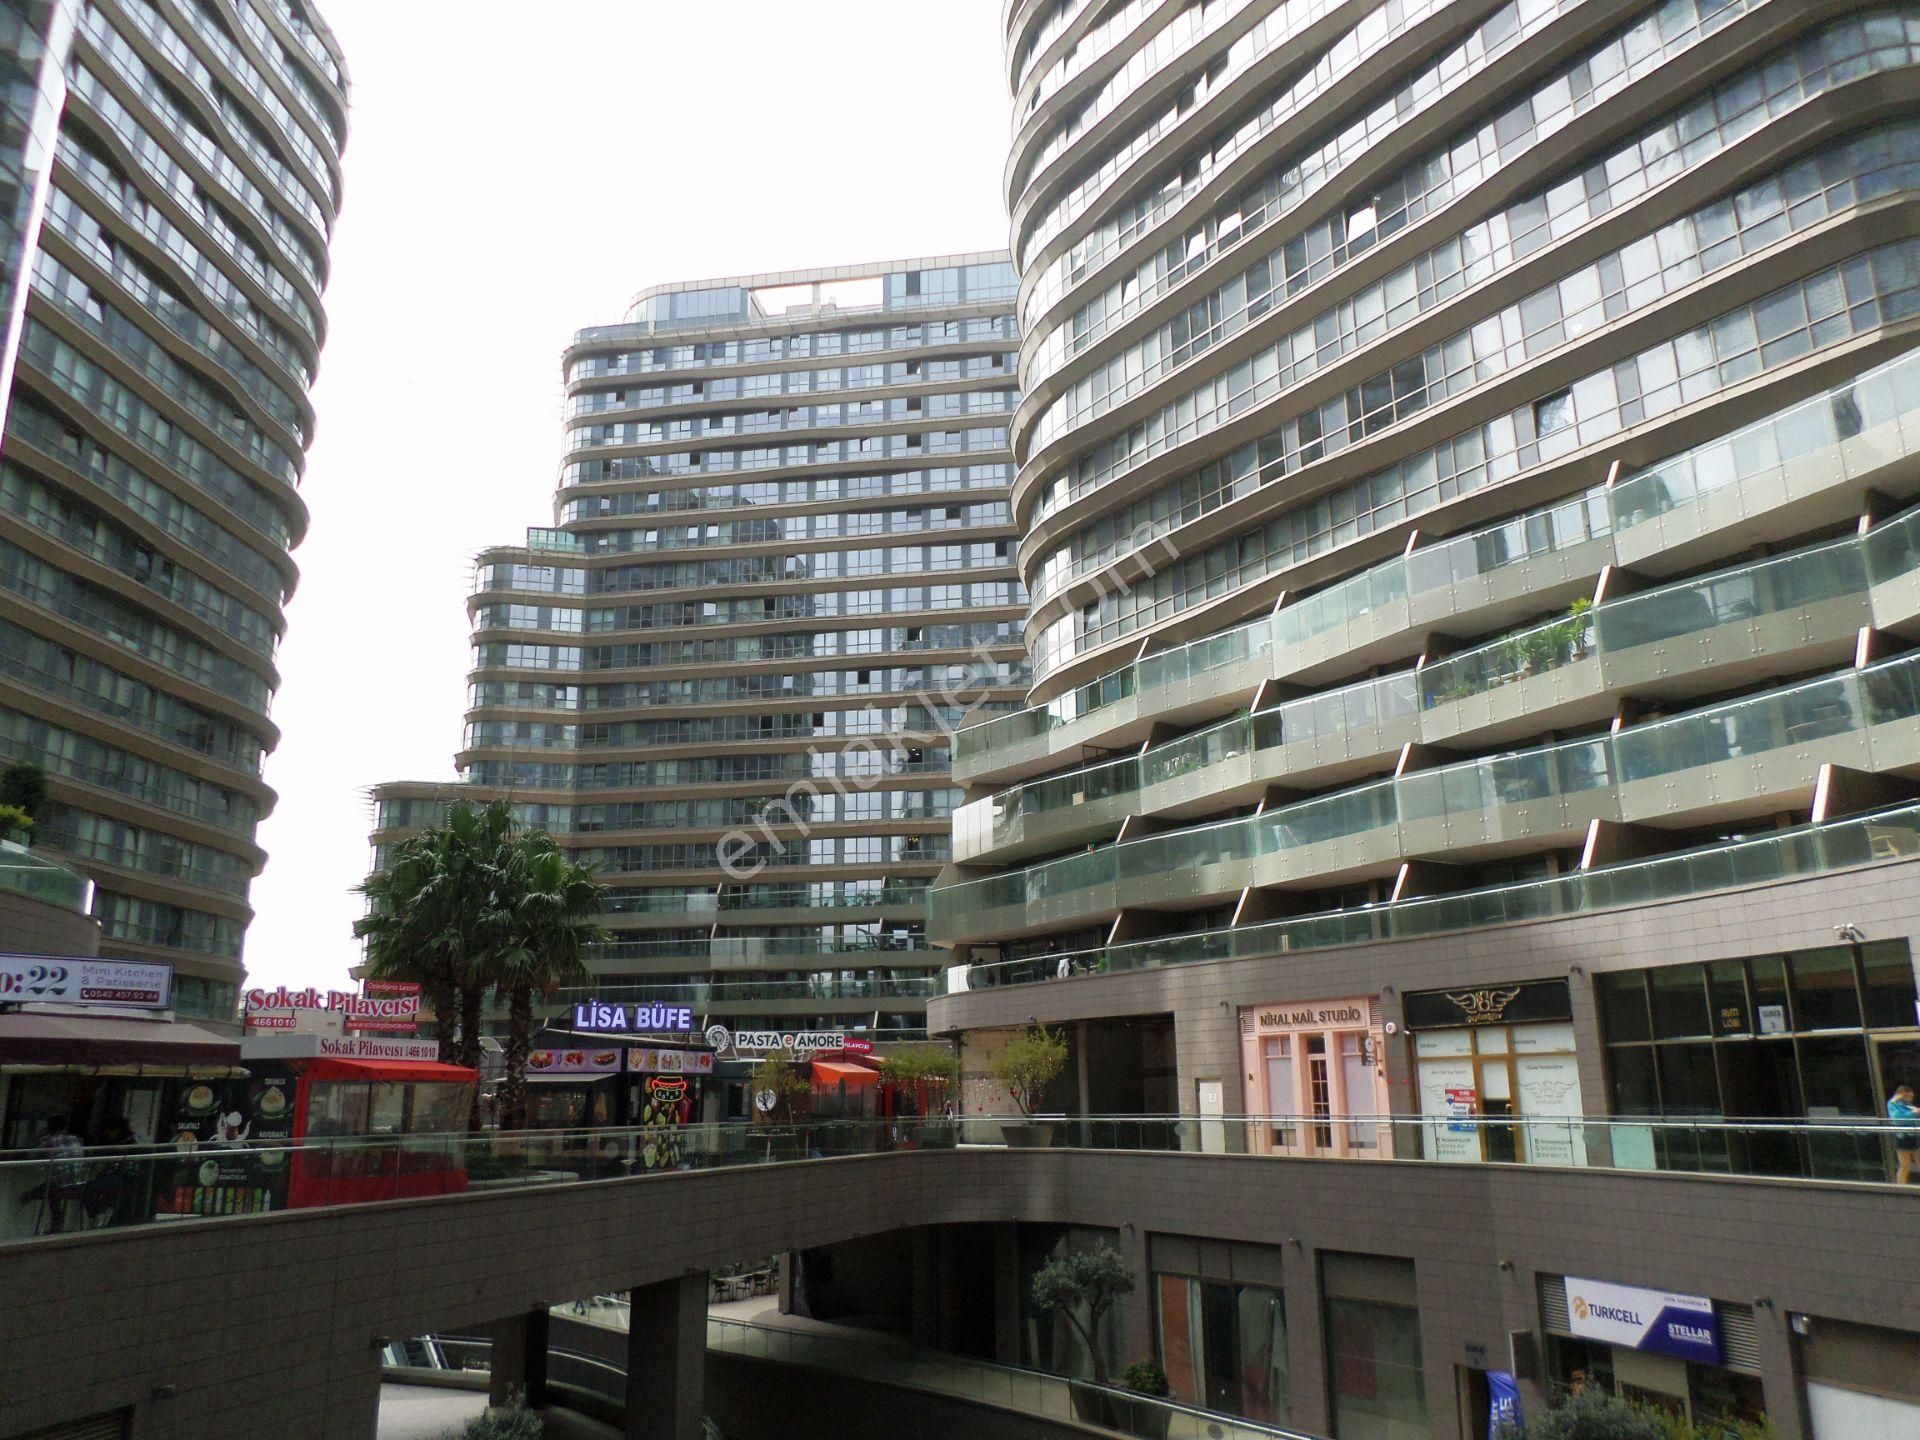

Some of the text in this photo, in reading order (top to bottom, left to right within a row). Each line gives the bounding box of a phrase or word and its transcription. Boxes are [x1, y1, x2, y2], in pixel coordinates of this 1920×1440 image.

[82, 965, 164, 978] Mini Kitchen
[96, 977, 162, 988] Patisserie
[247, 986, 419, 1016] Sokak Pilavcısı
[576, 1001, 691, 1029] LİSA BÜFE
[1260, 1006, 1360, 1027] NİHAL NAİL STUDİO
[320, 1038, 355, 1055] Sokak
[358, 1040, 403, 1057] Pilavcısı
[738, 1034, 780, 1047] PASTA
[785, 1037, 792, 1046] e
[797, 1035, 844, 1048] AMORE
[1588, 1303, 1643, 1326] TURKCELL
[1668, 1323, 1711, 1340] STELLAR
